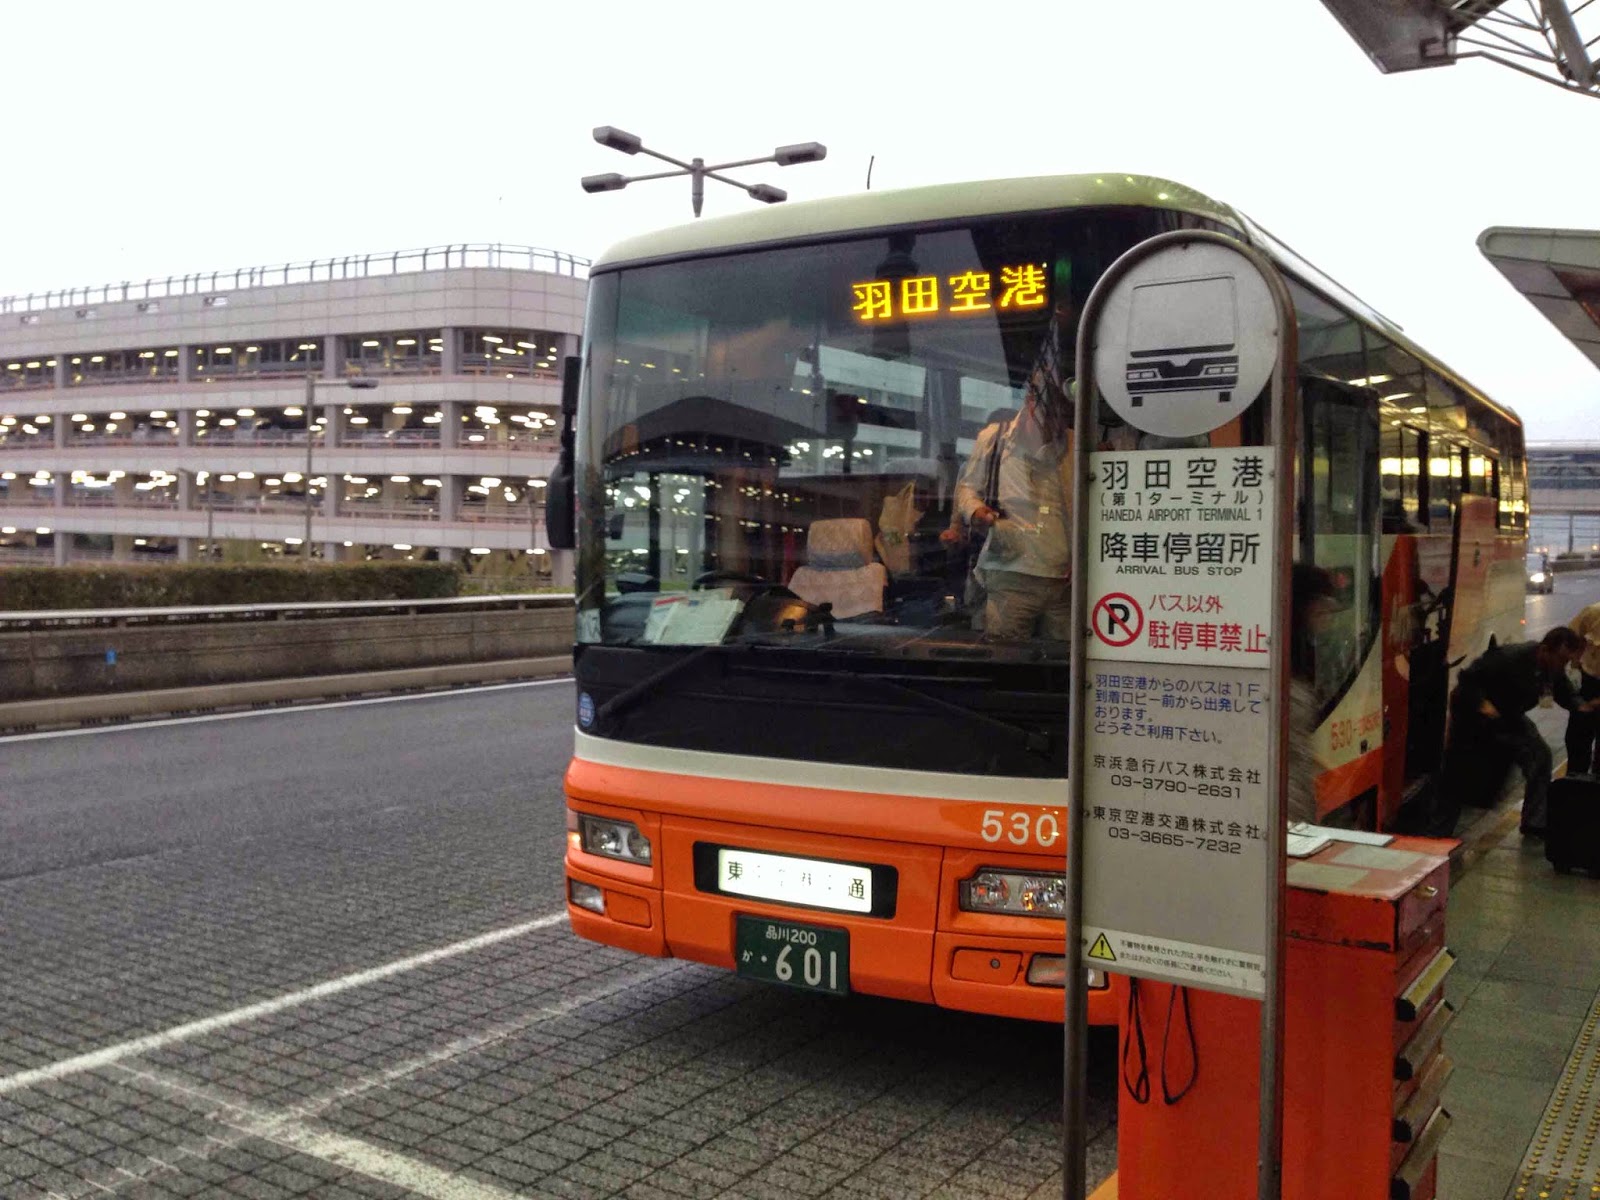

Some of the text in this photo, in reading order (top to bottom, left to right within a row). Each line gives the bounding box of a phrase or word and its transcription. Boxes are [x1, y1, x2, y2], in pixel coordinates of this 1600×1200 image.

[852, 265, 1046, 320] 羽田空港
[1102, 456, 1263, 490] 羽田空港
[1101, 508, 1262, 522] HANEDA AIRPORT TERMINAL 1
[1100, 532, 1261, 565] 降車停留所
[1116, 566, 1243, 576] ARRIVAL BUS STOP
[1149, 594, 1224, 614] バス以外
[1148, 620, 1268, 653] 駐停車禁止
[1095, 674, 1261, 696] 羽田空港からのバスは1F
[1095, 689, 1262, 714] 到着ロビー前から出発して
[1093, 722, 1223, 745] どうぞご利用下さい。
[1093, 754, 1261, 785] 京浜急行バス株式会社
[1111, 774, 1241, 799] 03-3790-2631
[981, 809, 1058, 847] 530
[1093, 806, 1261, 840] 東京空港交通株式会社
[1108, 826, 1242, 855] 03-3665-7232
[765, 925, 817, 946] 品川200
